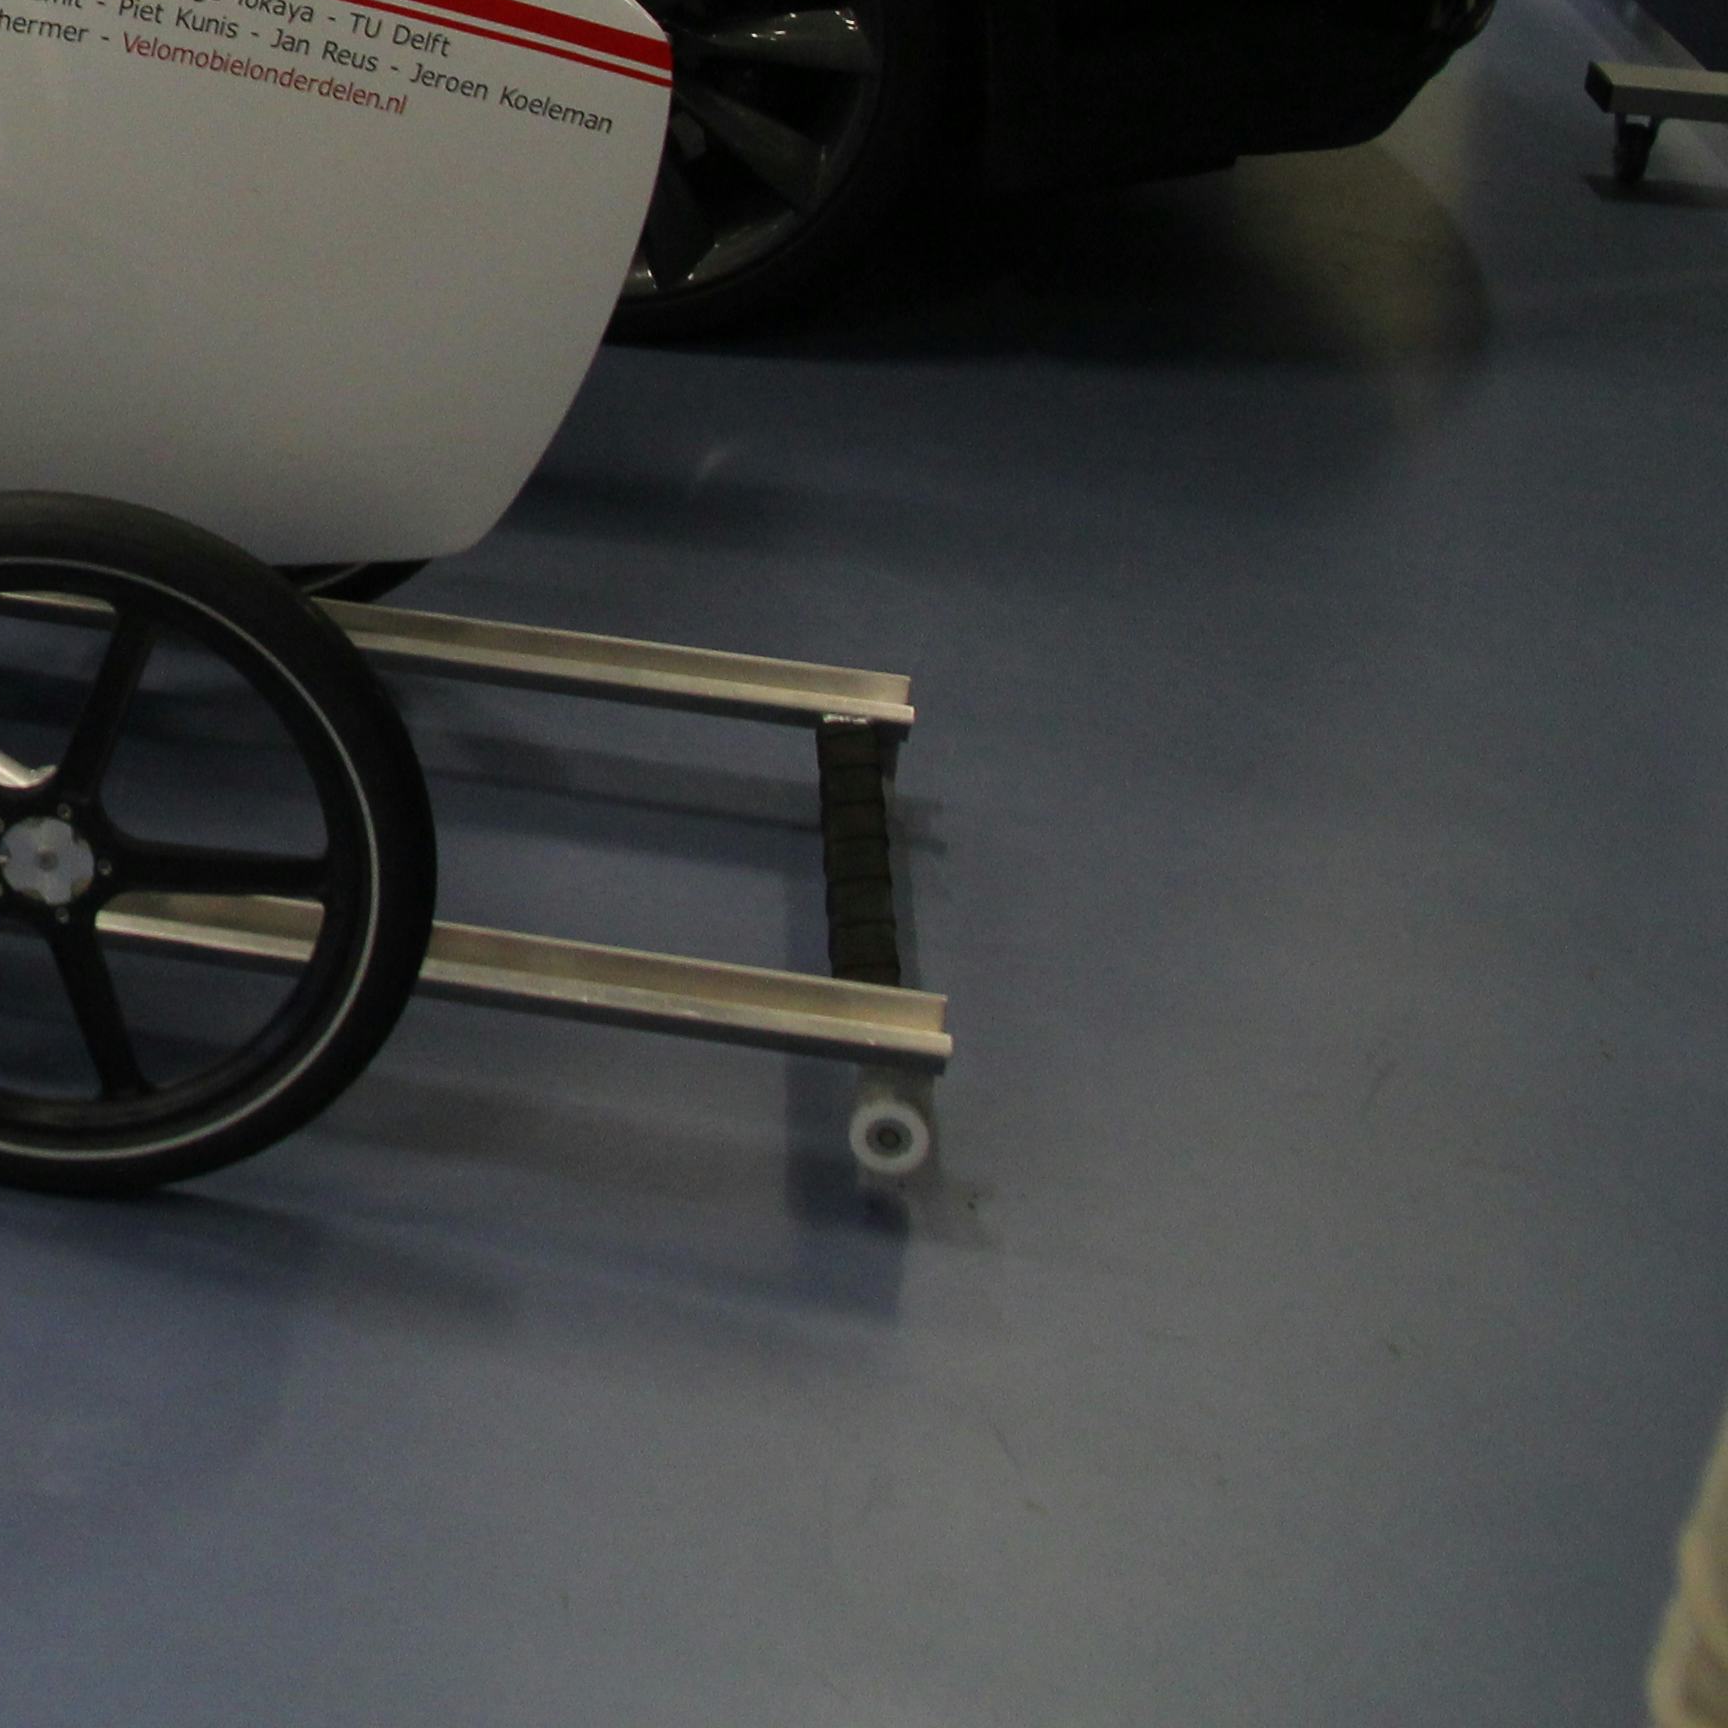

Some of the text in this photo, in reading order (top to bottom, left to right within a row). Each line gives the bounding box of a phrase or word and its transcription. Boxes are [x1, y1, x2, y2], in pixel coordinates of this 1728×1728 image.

[122, 31, 409, 116] Velomobielonderdelen.nl
[175, 7, 240, 39] Kunis
[270, 28, 310, 56] Jan
[321, 41, 379, 72] Reus
[409, 62, 489, 101] Jeroen
[499, 85, 614, 135] Koeleman
[349, 12, 383, 39] TU
[391, 23, 452, 58] Delft
